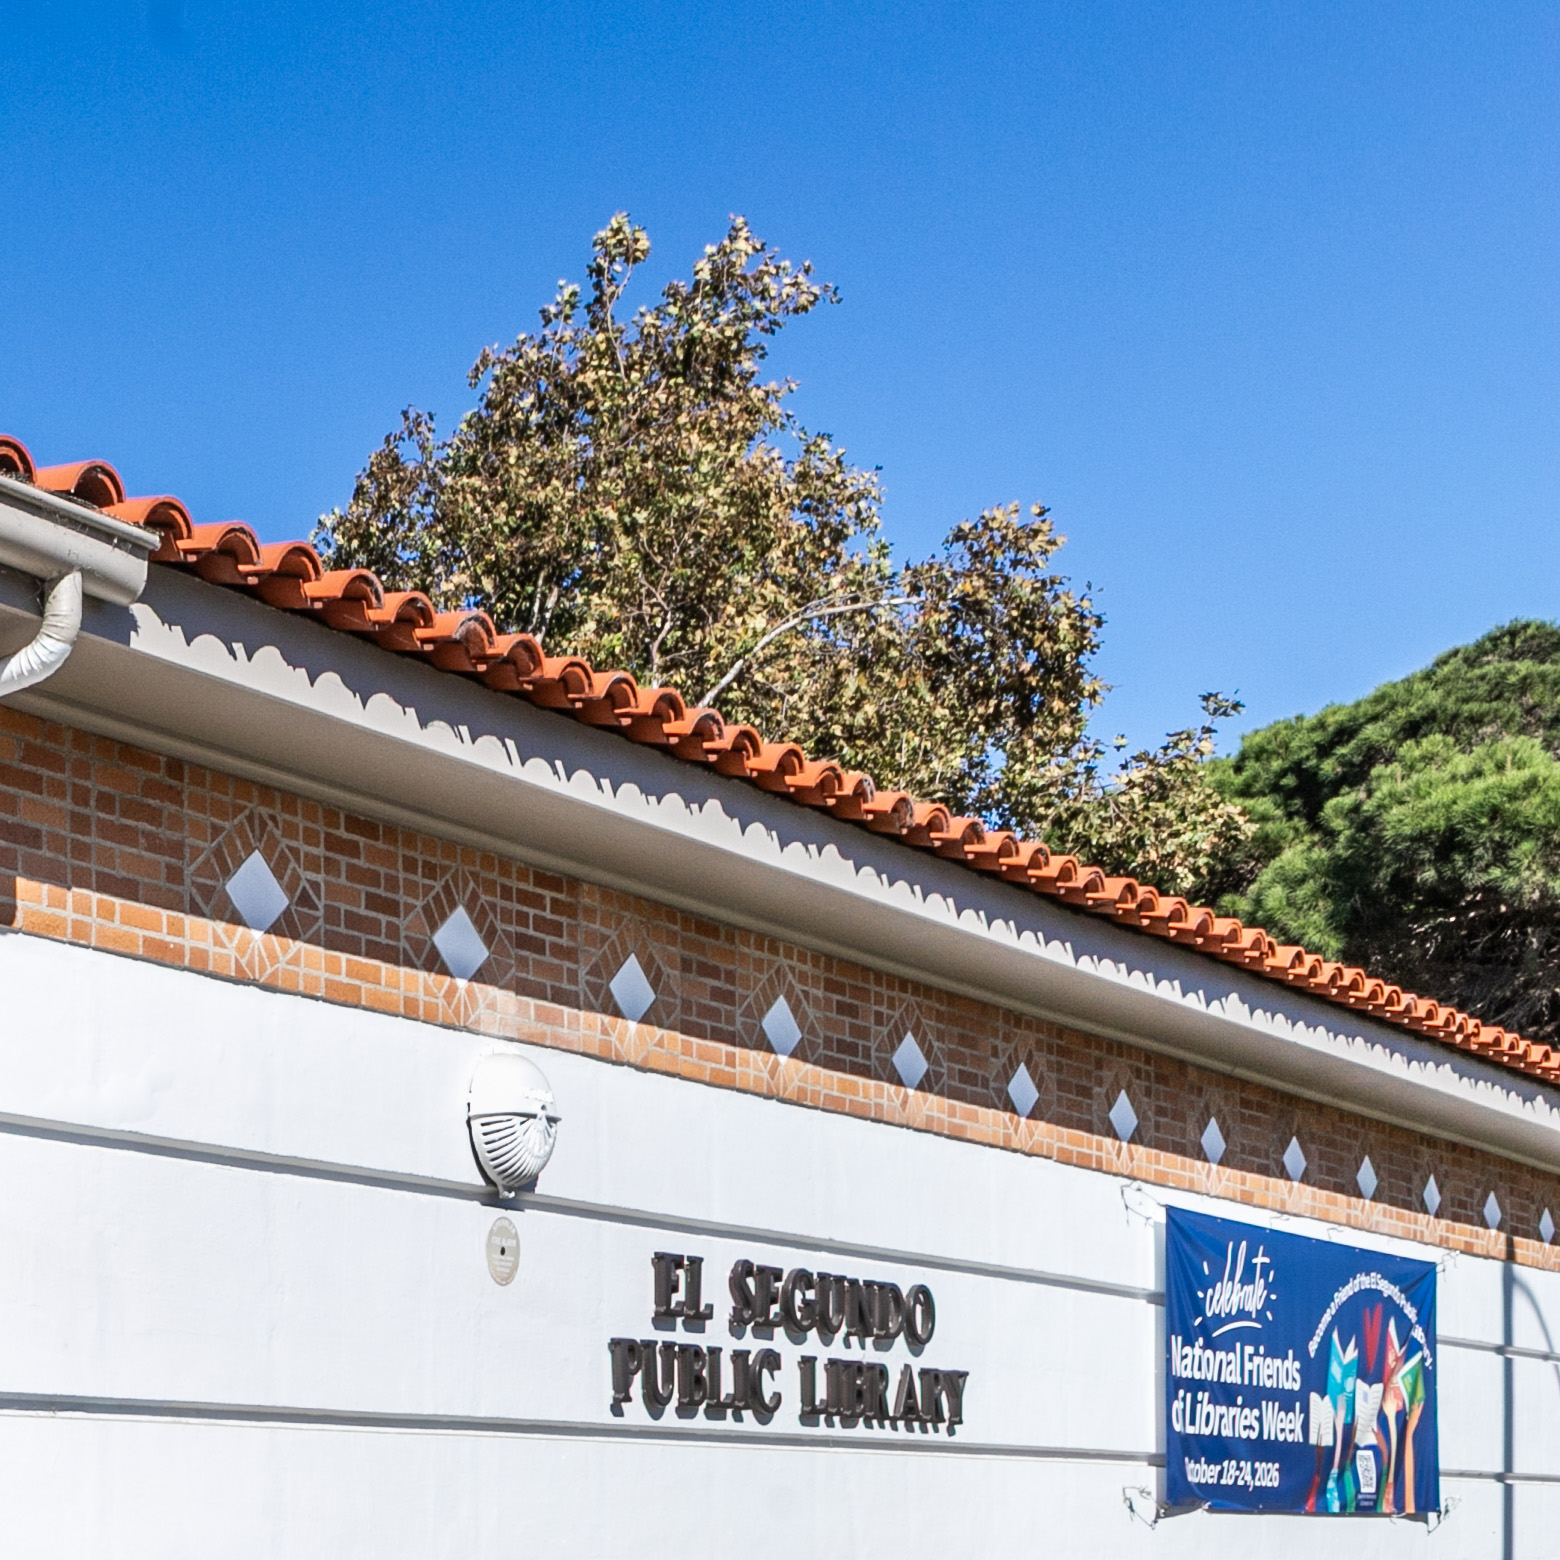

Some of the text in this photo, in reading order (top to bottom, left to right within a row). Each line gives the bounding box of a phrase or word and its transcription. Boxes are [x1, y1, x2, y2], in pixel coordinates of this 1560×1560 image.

[651, 1251, 936, 1345] EL SEGUNDO
[1205, 1240, 1270, 1318] celebrate
[608, 1337, 969, 1425] PUBLIC LIBRARY
[1171, 1334, 1301, 1391] National Friends
[1185, 1391, 1260, 1440] Libraries
[1261, 1400, 1305, 1443] Week
[1184, 1456, 1221, 1485] tober
